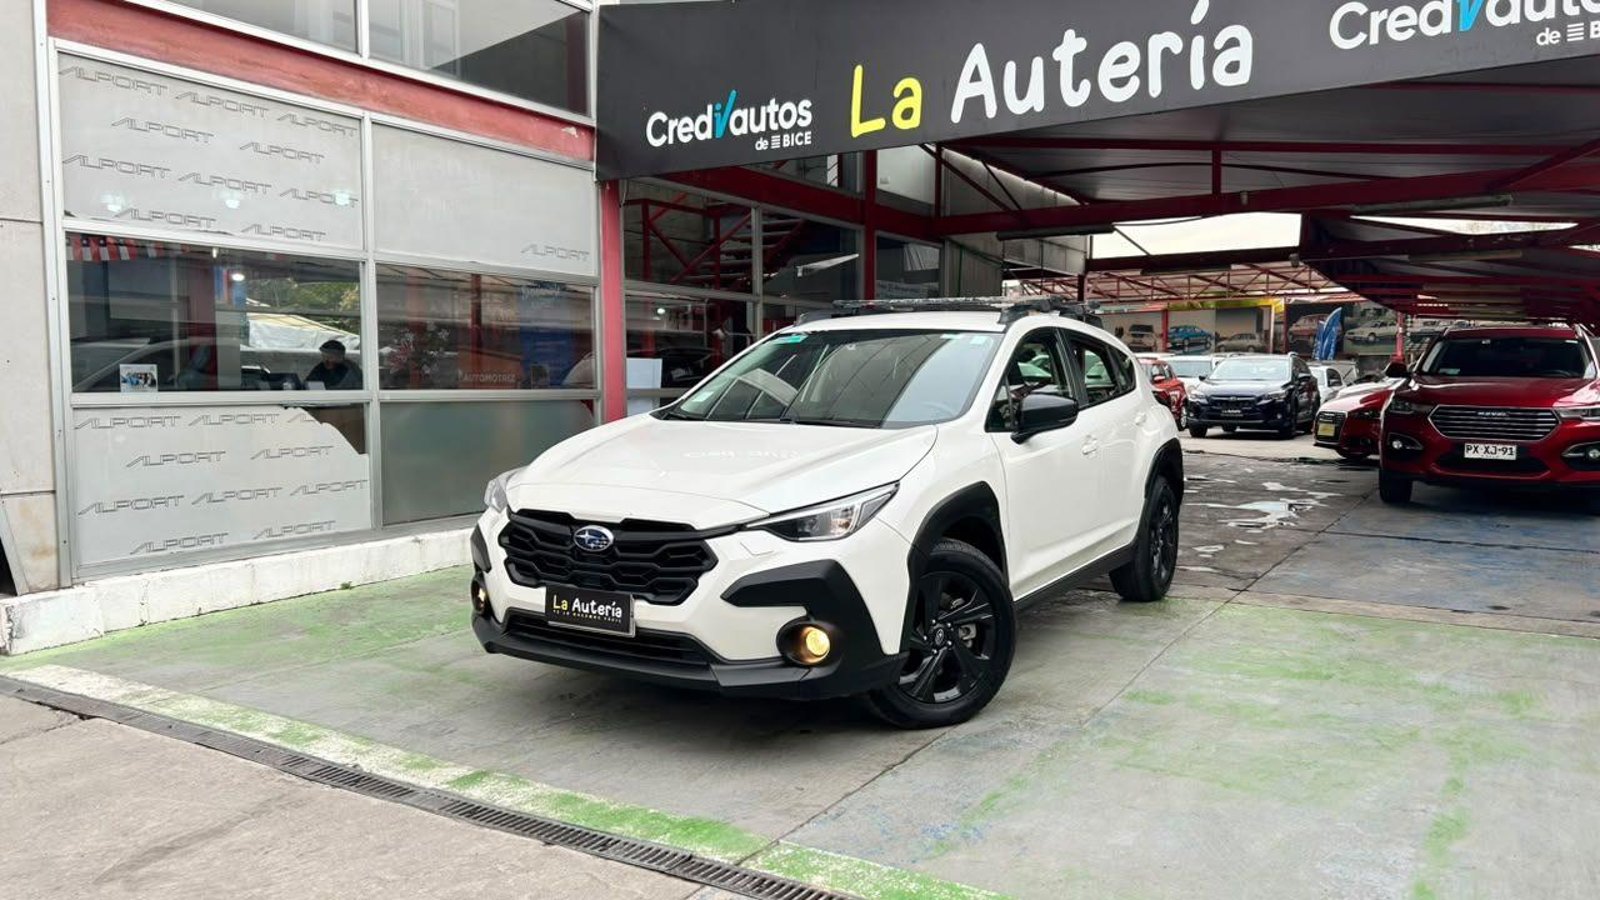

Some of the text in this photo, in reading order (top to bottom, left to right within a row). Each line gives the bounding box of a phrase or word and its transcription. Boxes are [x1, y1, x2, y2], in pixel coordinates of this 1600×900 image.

[1535, 27, 1561, 46] de
[850, 0, 1253, 138] La Autería
[755, 131, 812, 150] de BICE
[553, 595, 568, 611] La
[572, 598, 622, 618] Autería
